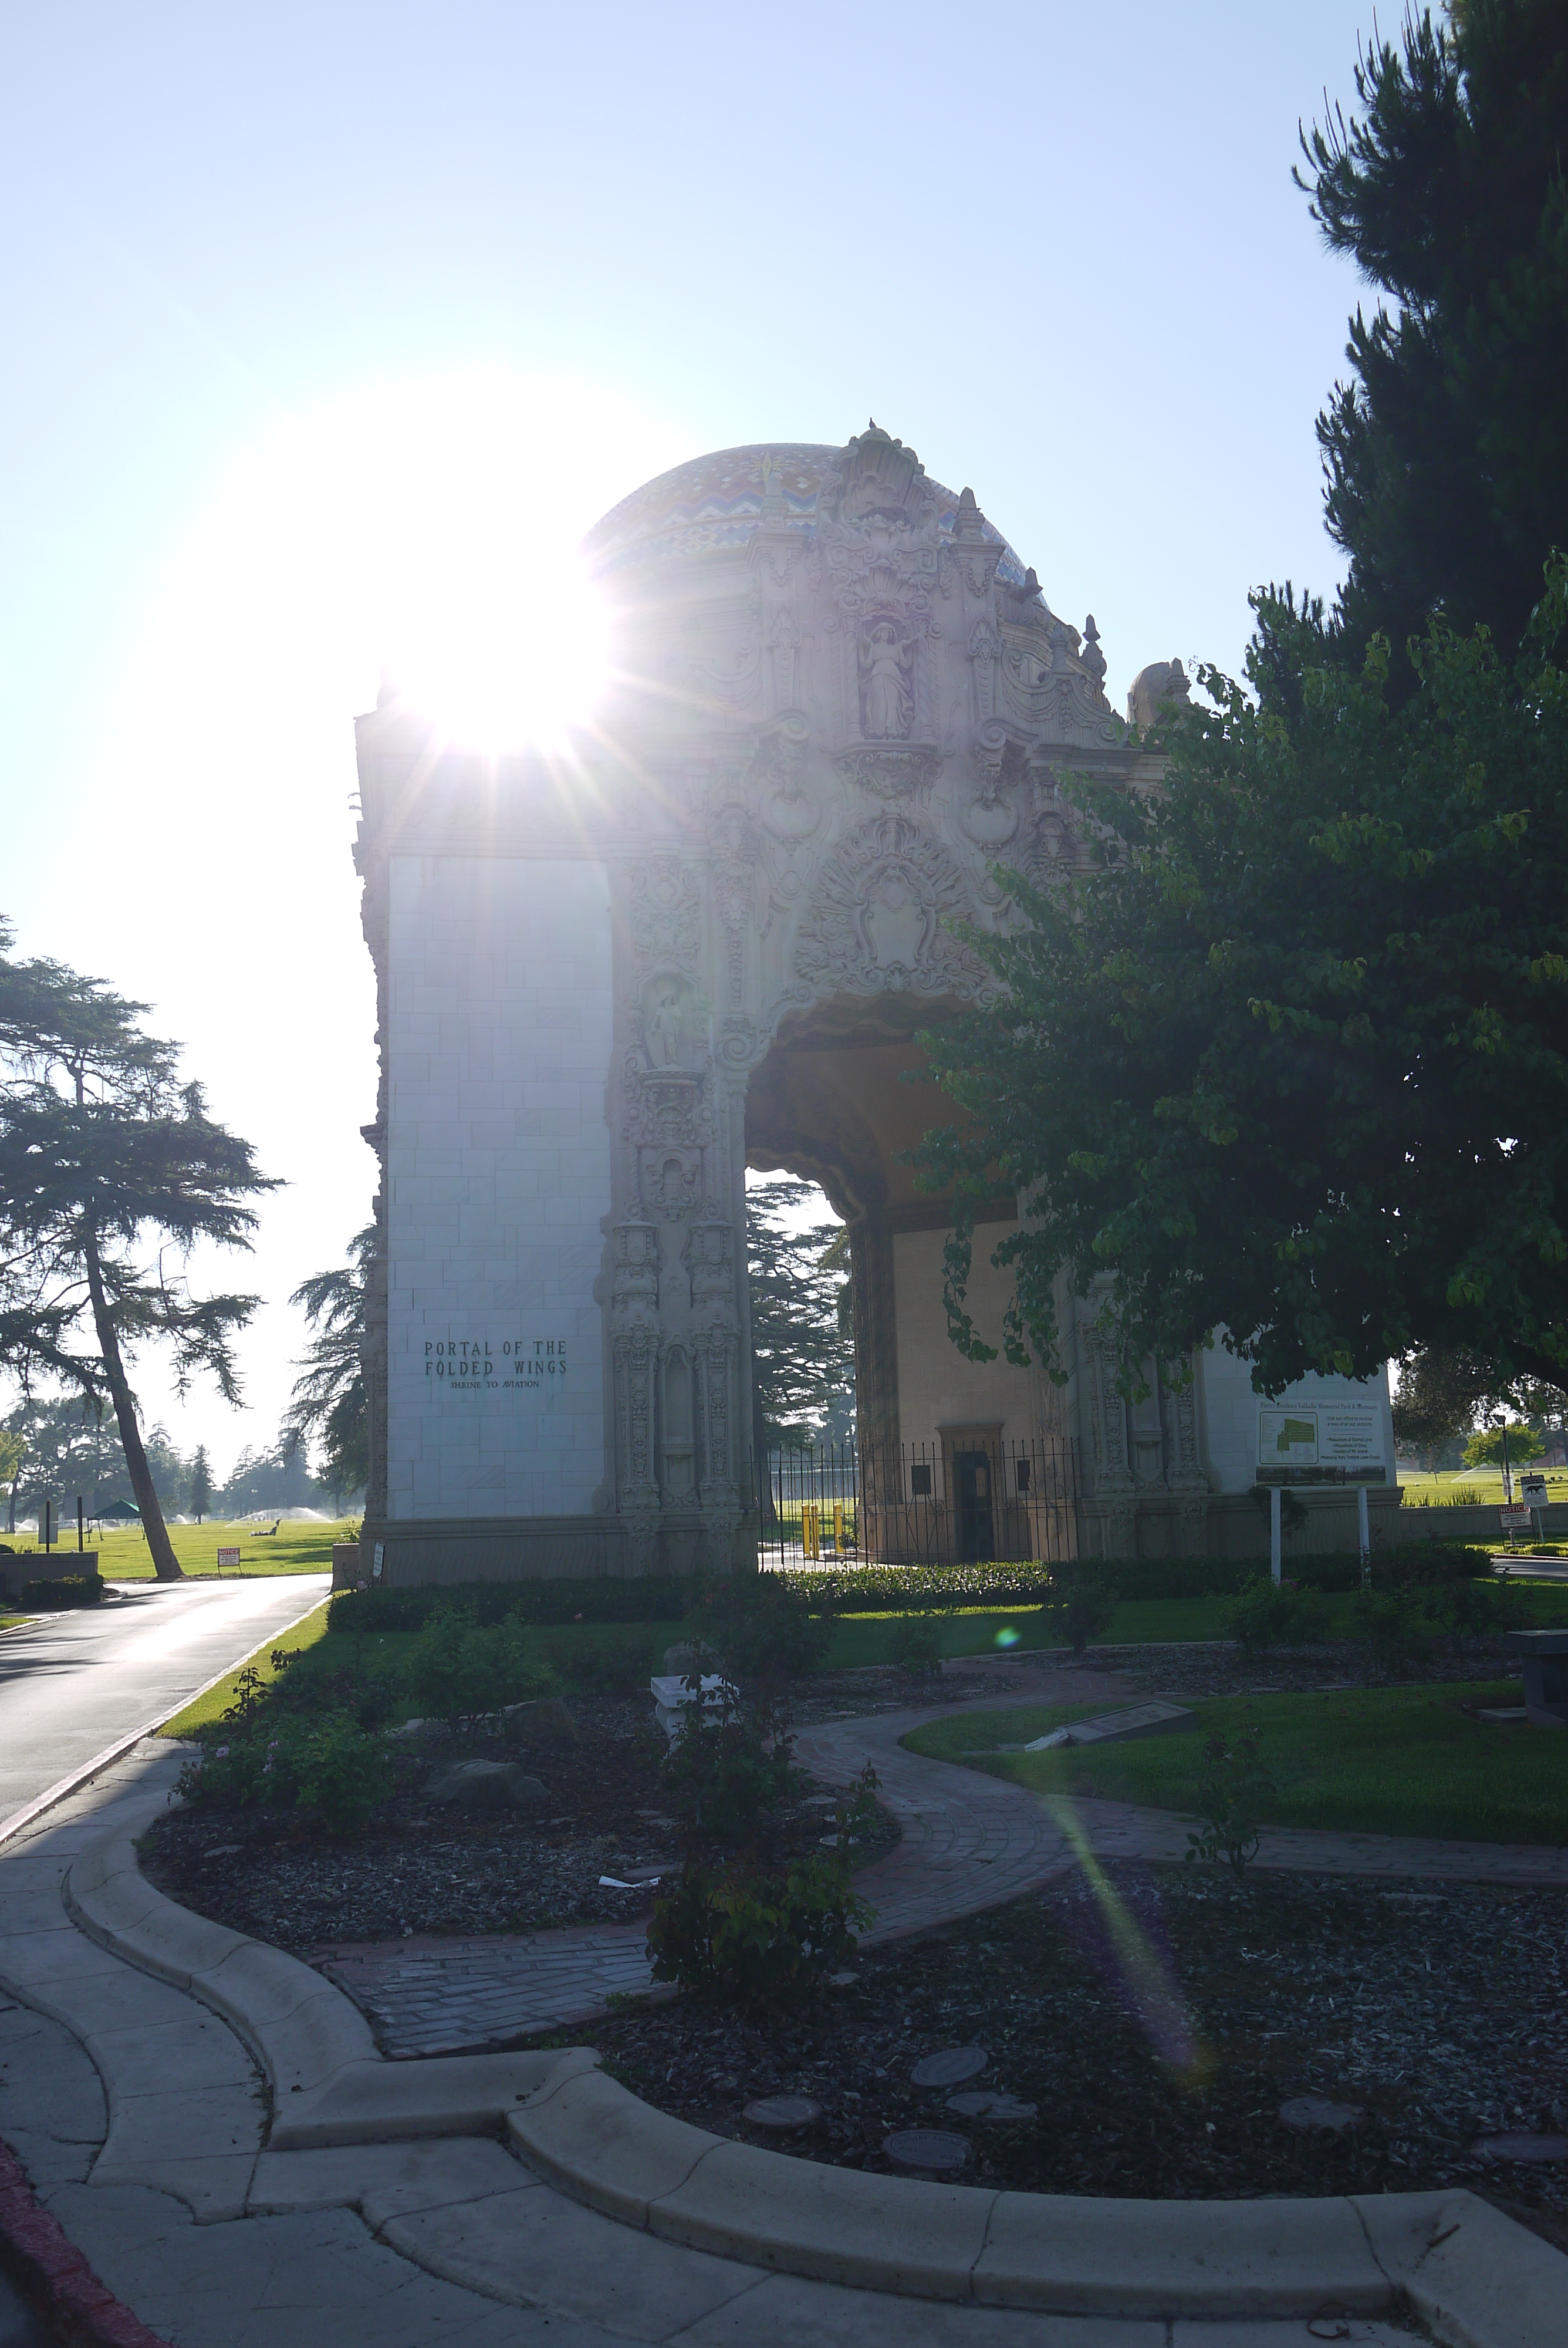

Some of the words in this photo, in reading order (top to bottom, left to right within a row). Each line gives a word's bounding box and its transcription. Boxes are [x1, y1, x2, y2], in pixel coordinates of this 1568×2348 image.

[425, 1341, 492, 1355] PORTAL
[503, 1341, 522, 1355] OF
[533, 1341, 566, 1354] THE
[425, 1361, 493, 1375] FOLDED
[514, 1360, 566, 1374] WINGS
